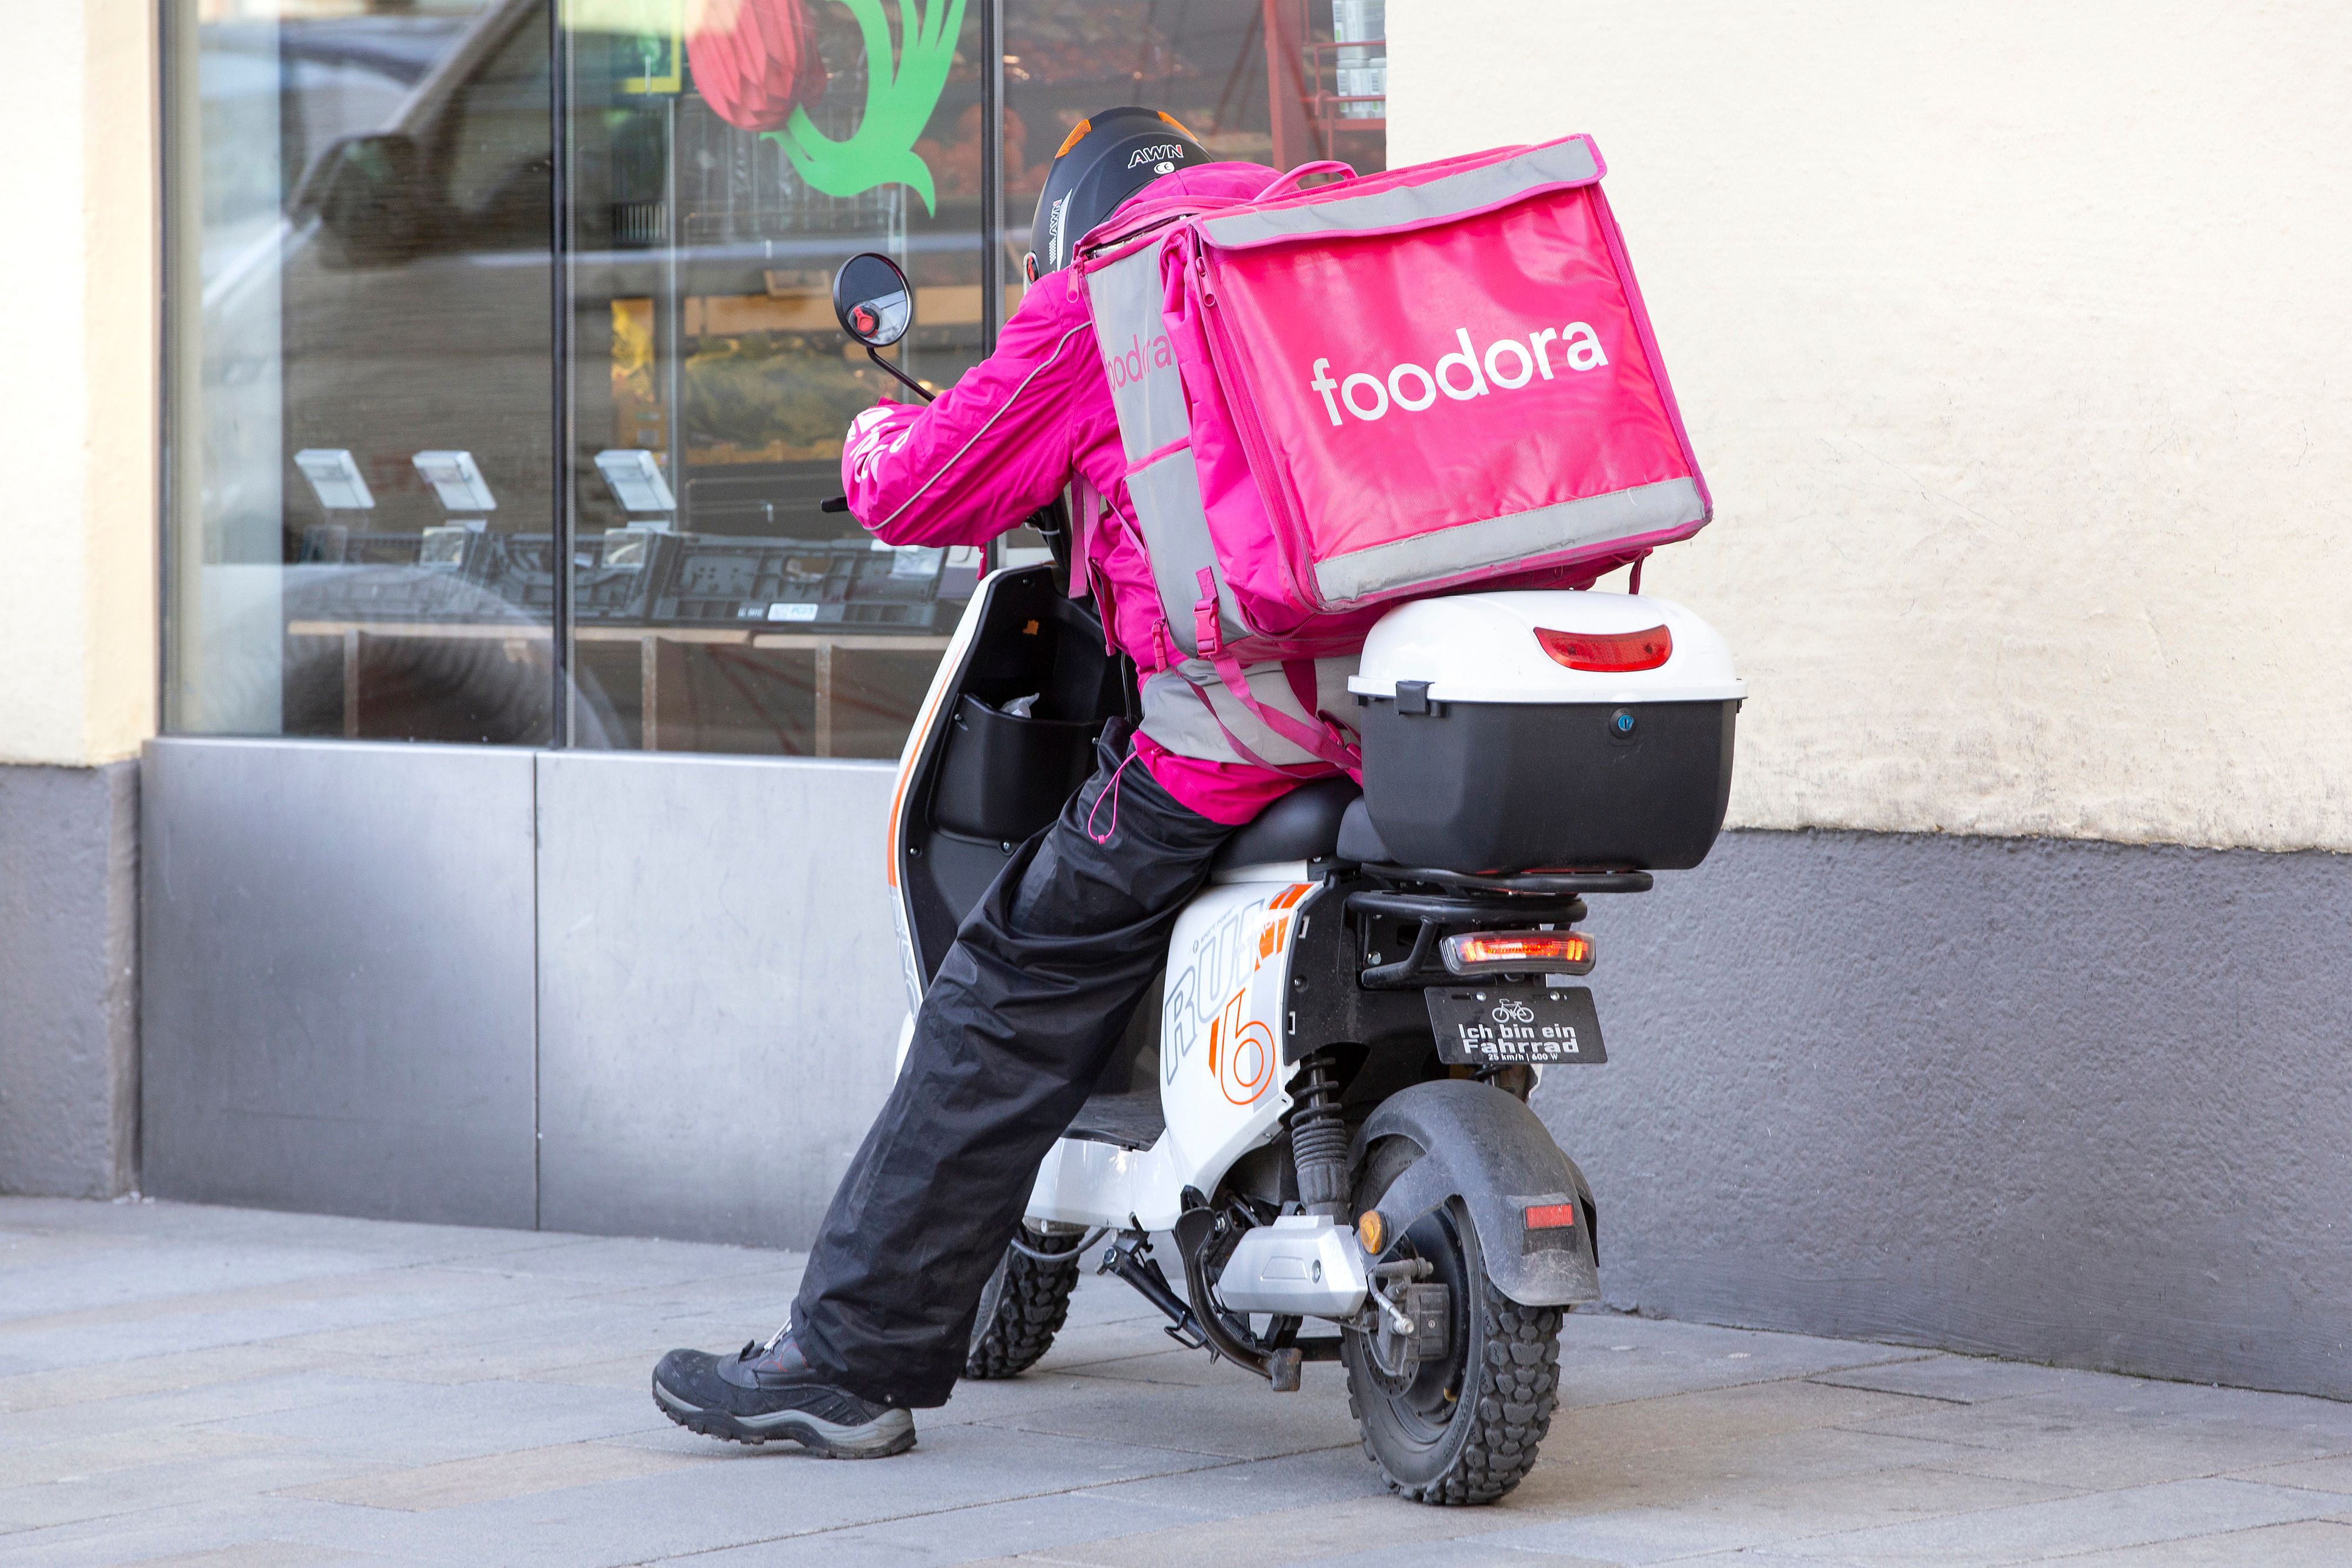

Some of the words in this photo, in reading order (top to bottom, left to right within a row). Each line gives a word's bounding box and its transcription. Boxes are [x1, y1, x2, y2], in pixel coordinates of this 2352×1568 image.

[1127, 144, 1184, 169] AWN
[1155, 162, 1173, 173] CE
[1049, 198, 1063, 236] AWN
[1311, 320, 1609, 426] foodora
[1458, 1024, 1494, 1039] Ich
[1499, 1024, 1535, 1039] bin
[1541, 1023, 1576, 1039] ein
[1462, 1038, 1579, 1054] Fahrrad
